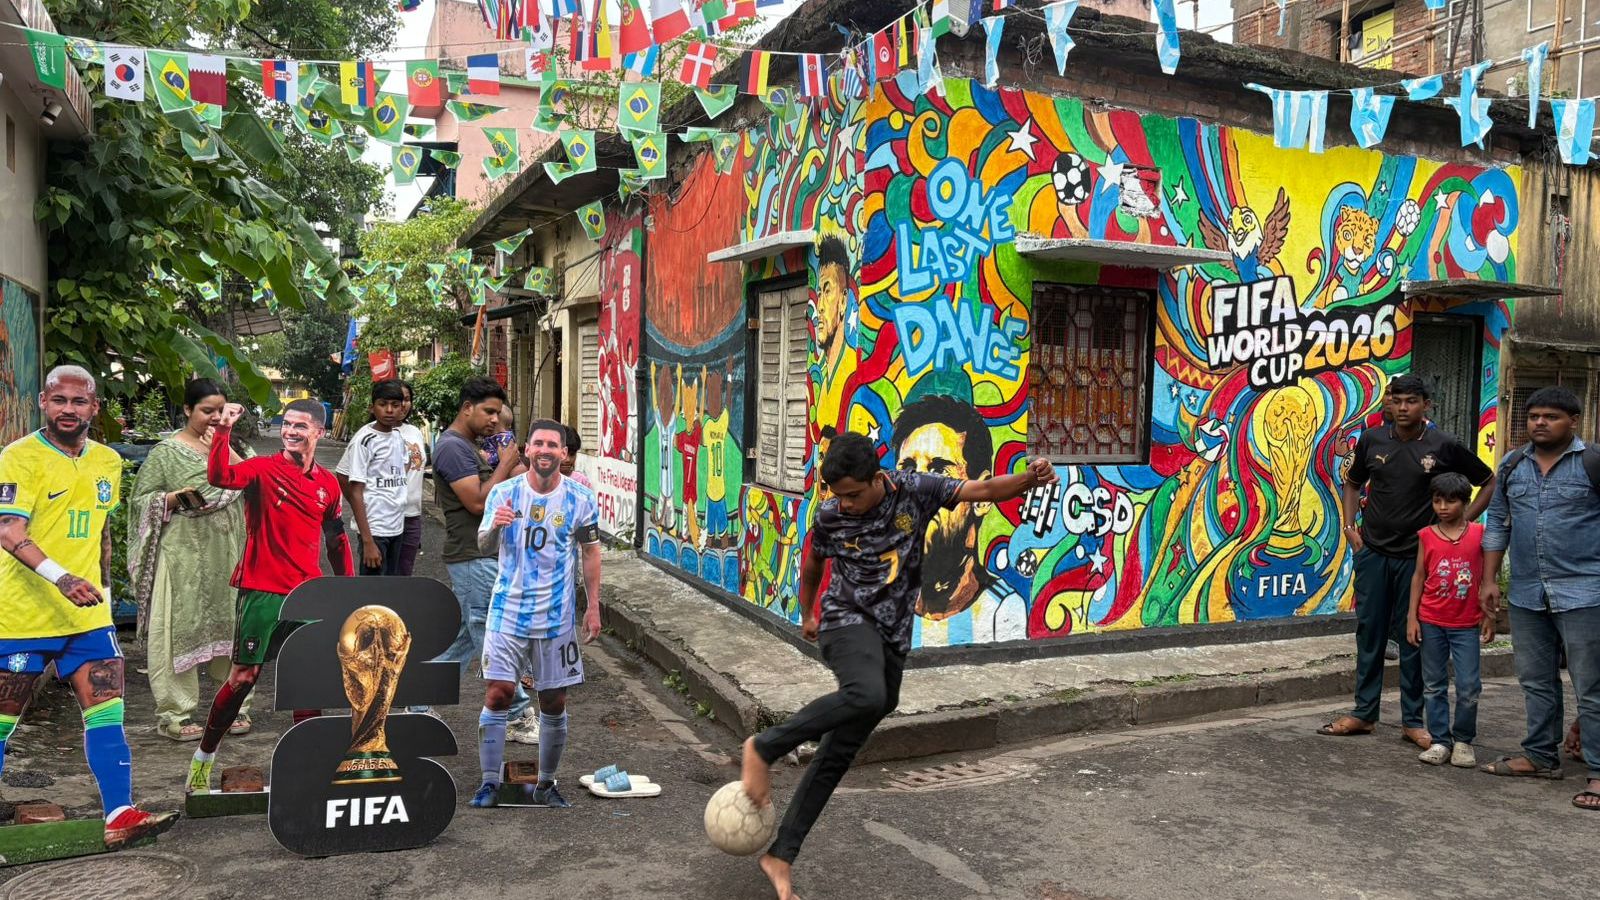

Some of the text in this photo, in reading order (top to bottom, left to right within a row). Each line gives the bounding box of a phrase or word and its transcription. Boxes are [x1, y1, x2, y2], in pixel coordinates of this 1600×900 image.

[928, 157, 1016, 245] ONE
[896, 218, 992, 297] LAST
[1213, 277, 1298, 334] FIFA
[893, 294, 1028, 382] DANCE
[1207, 304, 1396, 370] WORLD 2026
[1251, 352, 1304, 387] CUP
[687, 456, 693, 484] 7
[713, 441, 722, 477] 10
[67, 509, 90, 538] 10
[597, 492, 616, 529] FIFA
[524, 525, 548, 551] 10
[879, 548, 899, 584] 7
[1258, 572, 1307, 597] FIFA
[558, 641, 580, 669] 10
[325, 794, 410, 829] FIFA
